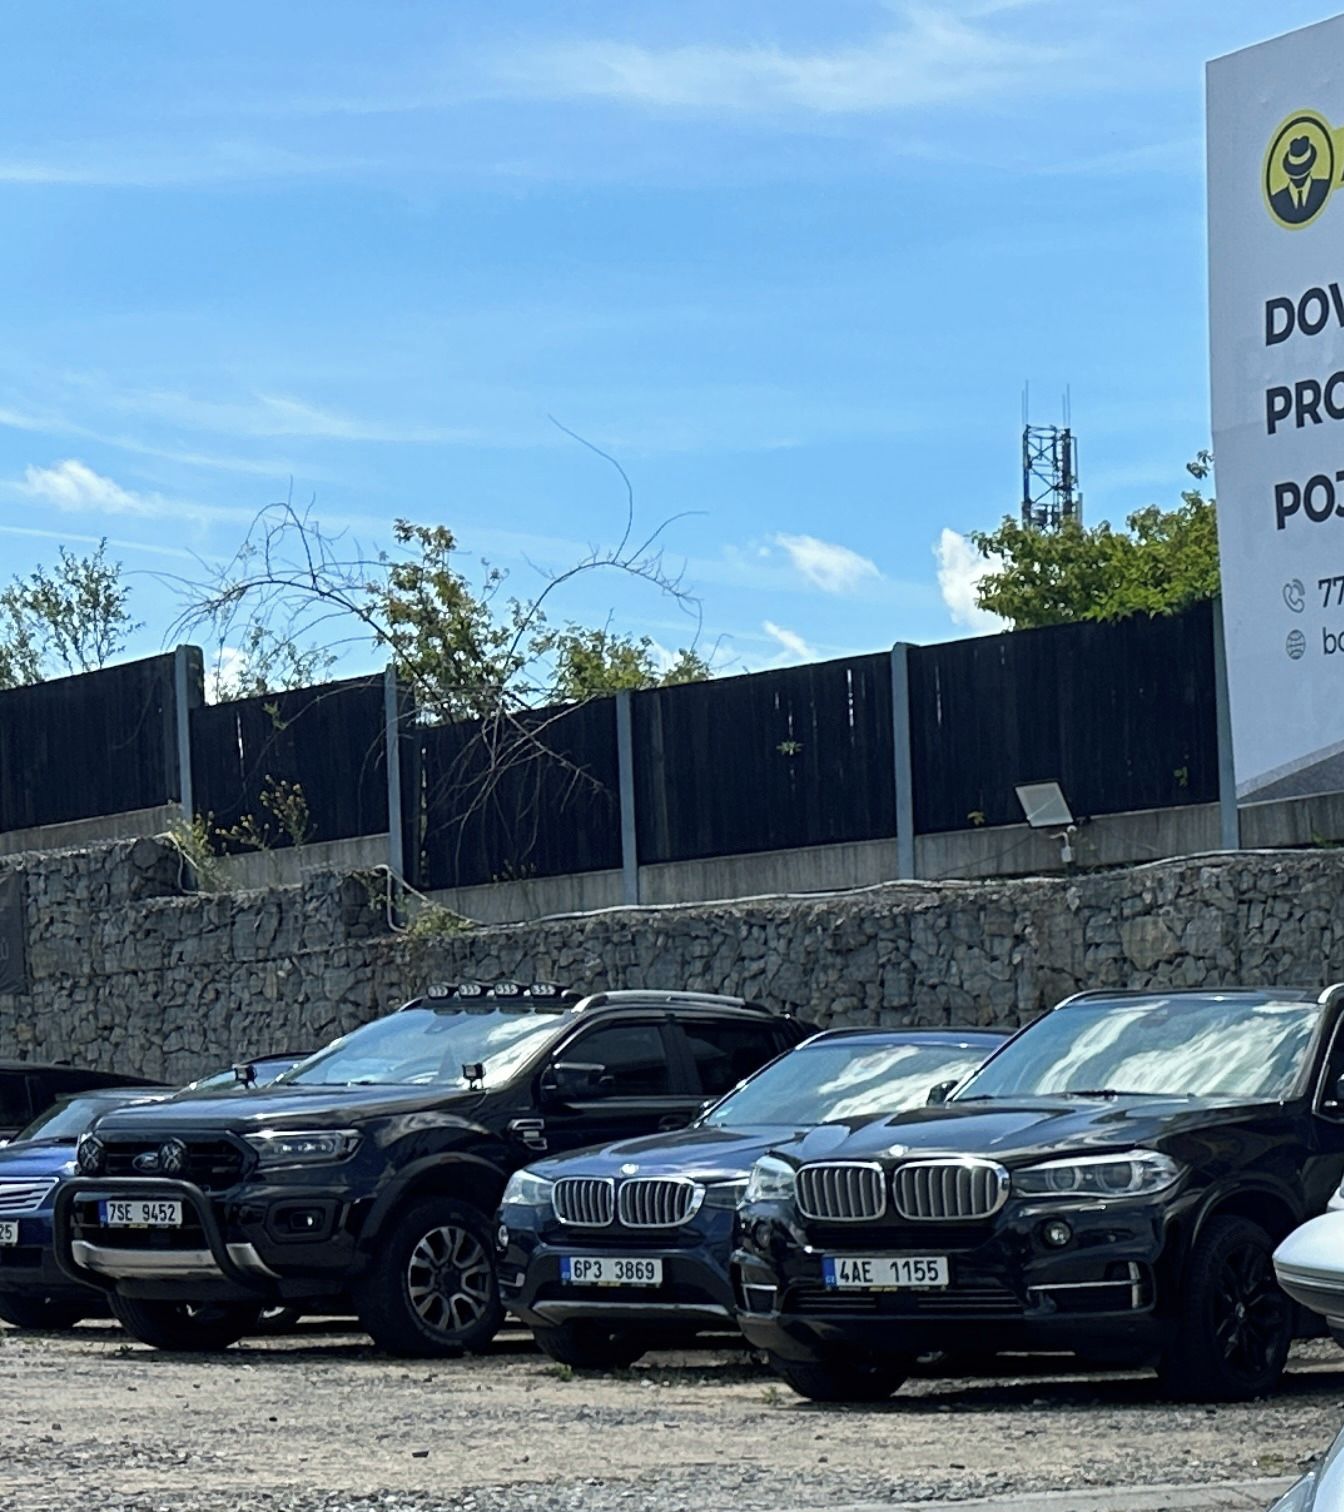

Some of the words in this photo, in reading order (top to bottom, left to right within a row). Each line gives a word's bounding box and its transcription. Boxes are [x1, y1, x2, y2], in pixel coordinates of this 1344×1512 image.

[109, 1203, 133, 1221] 7SE
[142, 1203, 176, 1221] 9452
[573, 1260, 602, 1279] 6P3
[615, 1261, 655, 1280] 3869
[839, 1260, 873, 1283] 4AE
[890, 1260, 939, 1282] 1155
